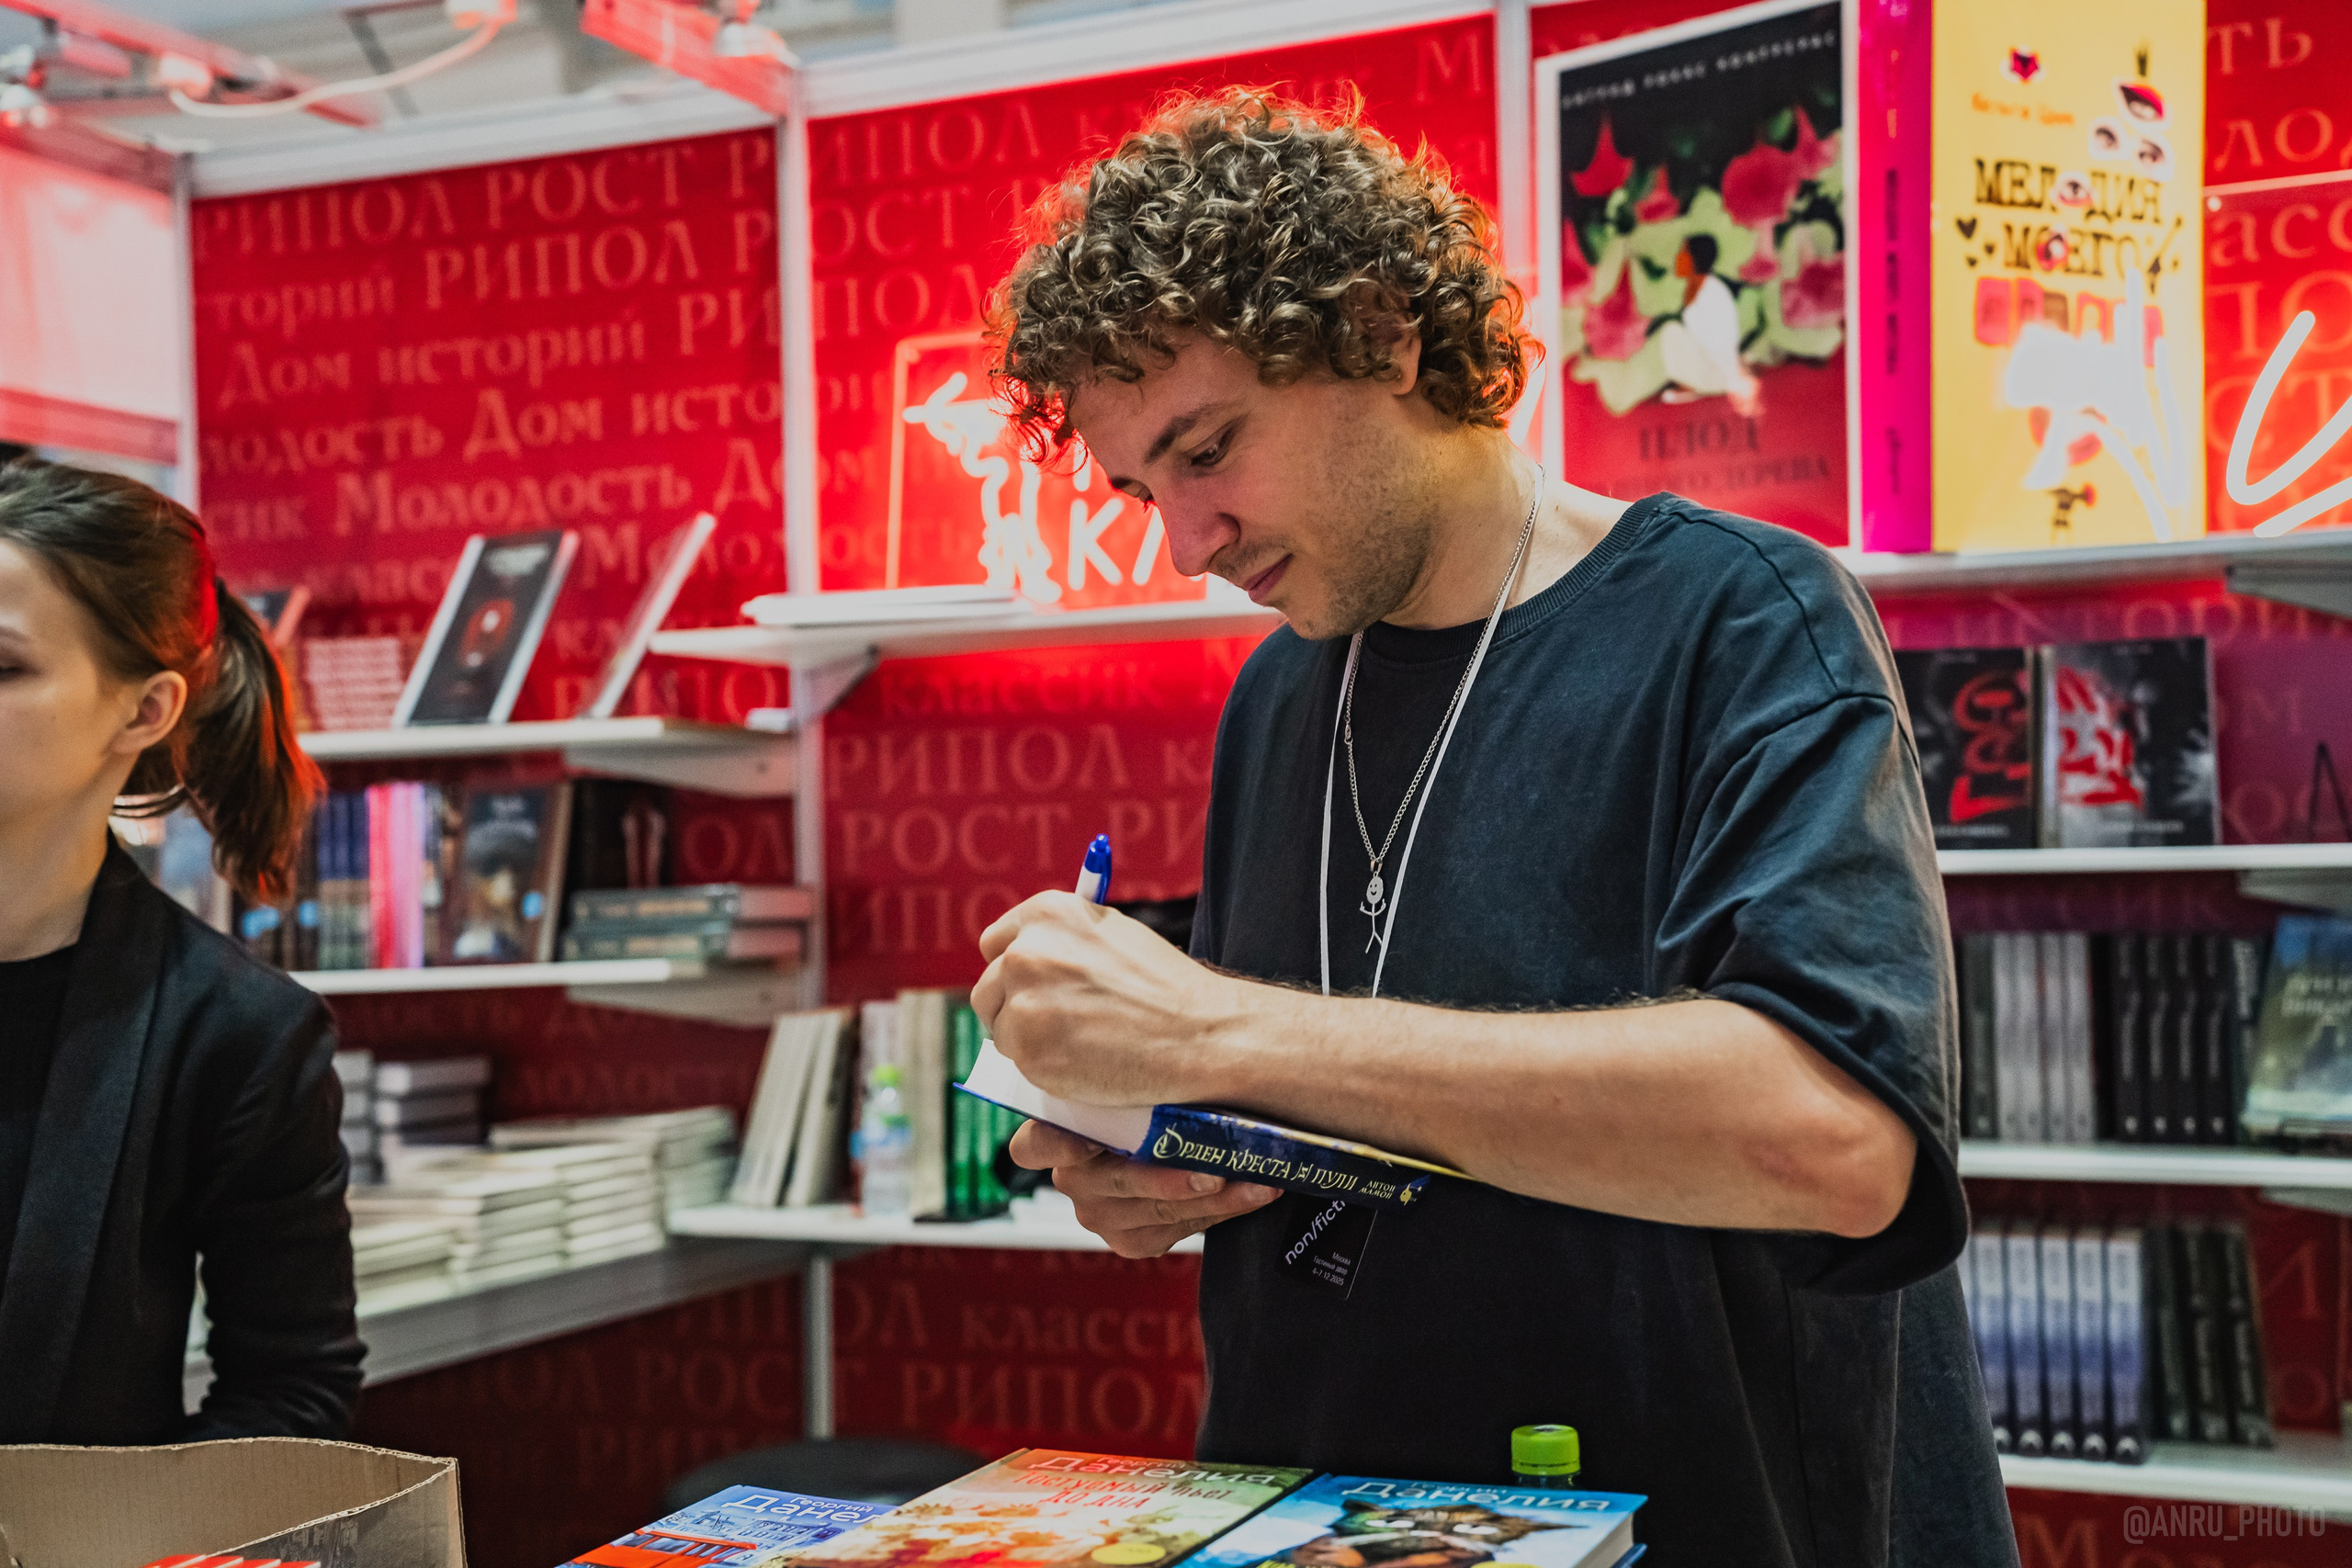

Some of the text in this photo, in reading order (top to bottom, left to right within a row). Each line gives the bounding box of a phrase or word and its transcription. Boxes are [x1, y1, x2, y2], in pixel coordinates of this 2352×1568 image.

[486, 143, 697, 231] РОСТ
[1973, 157, 2165, 225] МЕЛДИЯ
[424, 219, 700, 310] РИПОЛ
[218, 341, 352, 412] Дом
[379, 307, 644, 389] историй
[462, 387, 605, 462] Дом
[334, 463, 695, 537] Молодость
[828, 724, 1130, 799] РИПОЛ
[840, 802, 1071, 878] РОСТ
[1226, 1148, 1291, 1179] КРЕСТА
[1311, 1168, 1359, 1190] ПУЛИ
[1358, 1186, 1394, 1200] МАМОН
[1366, 1179, 1396, 1192] АНТОН
[789, 1496, 875, 1514] Георгий
[1027, 1456, 1276, 1485] Данелия
[1341, 1482, 1611, 1511] Данелия
